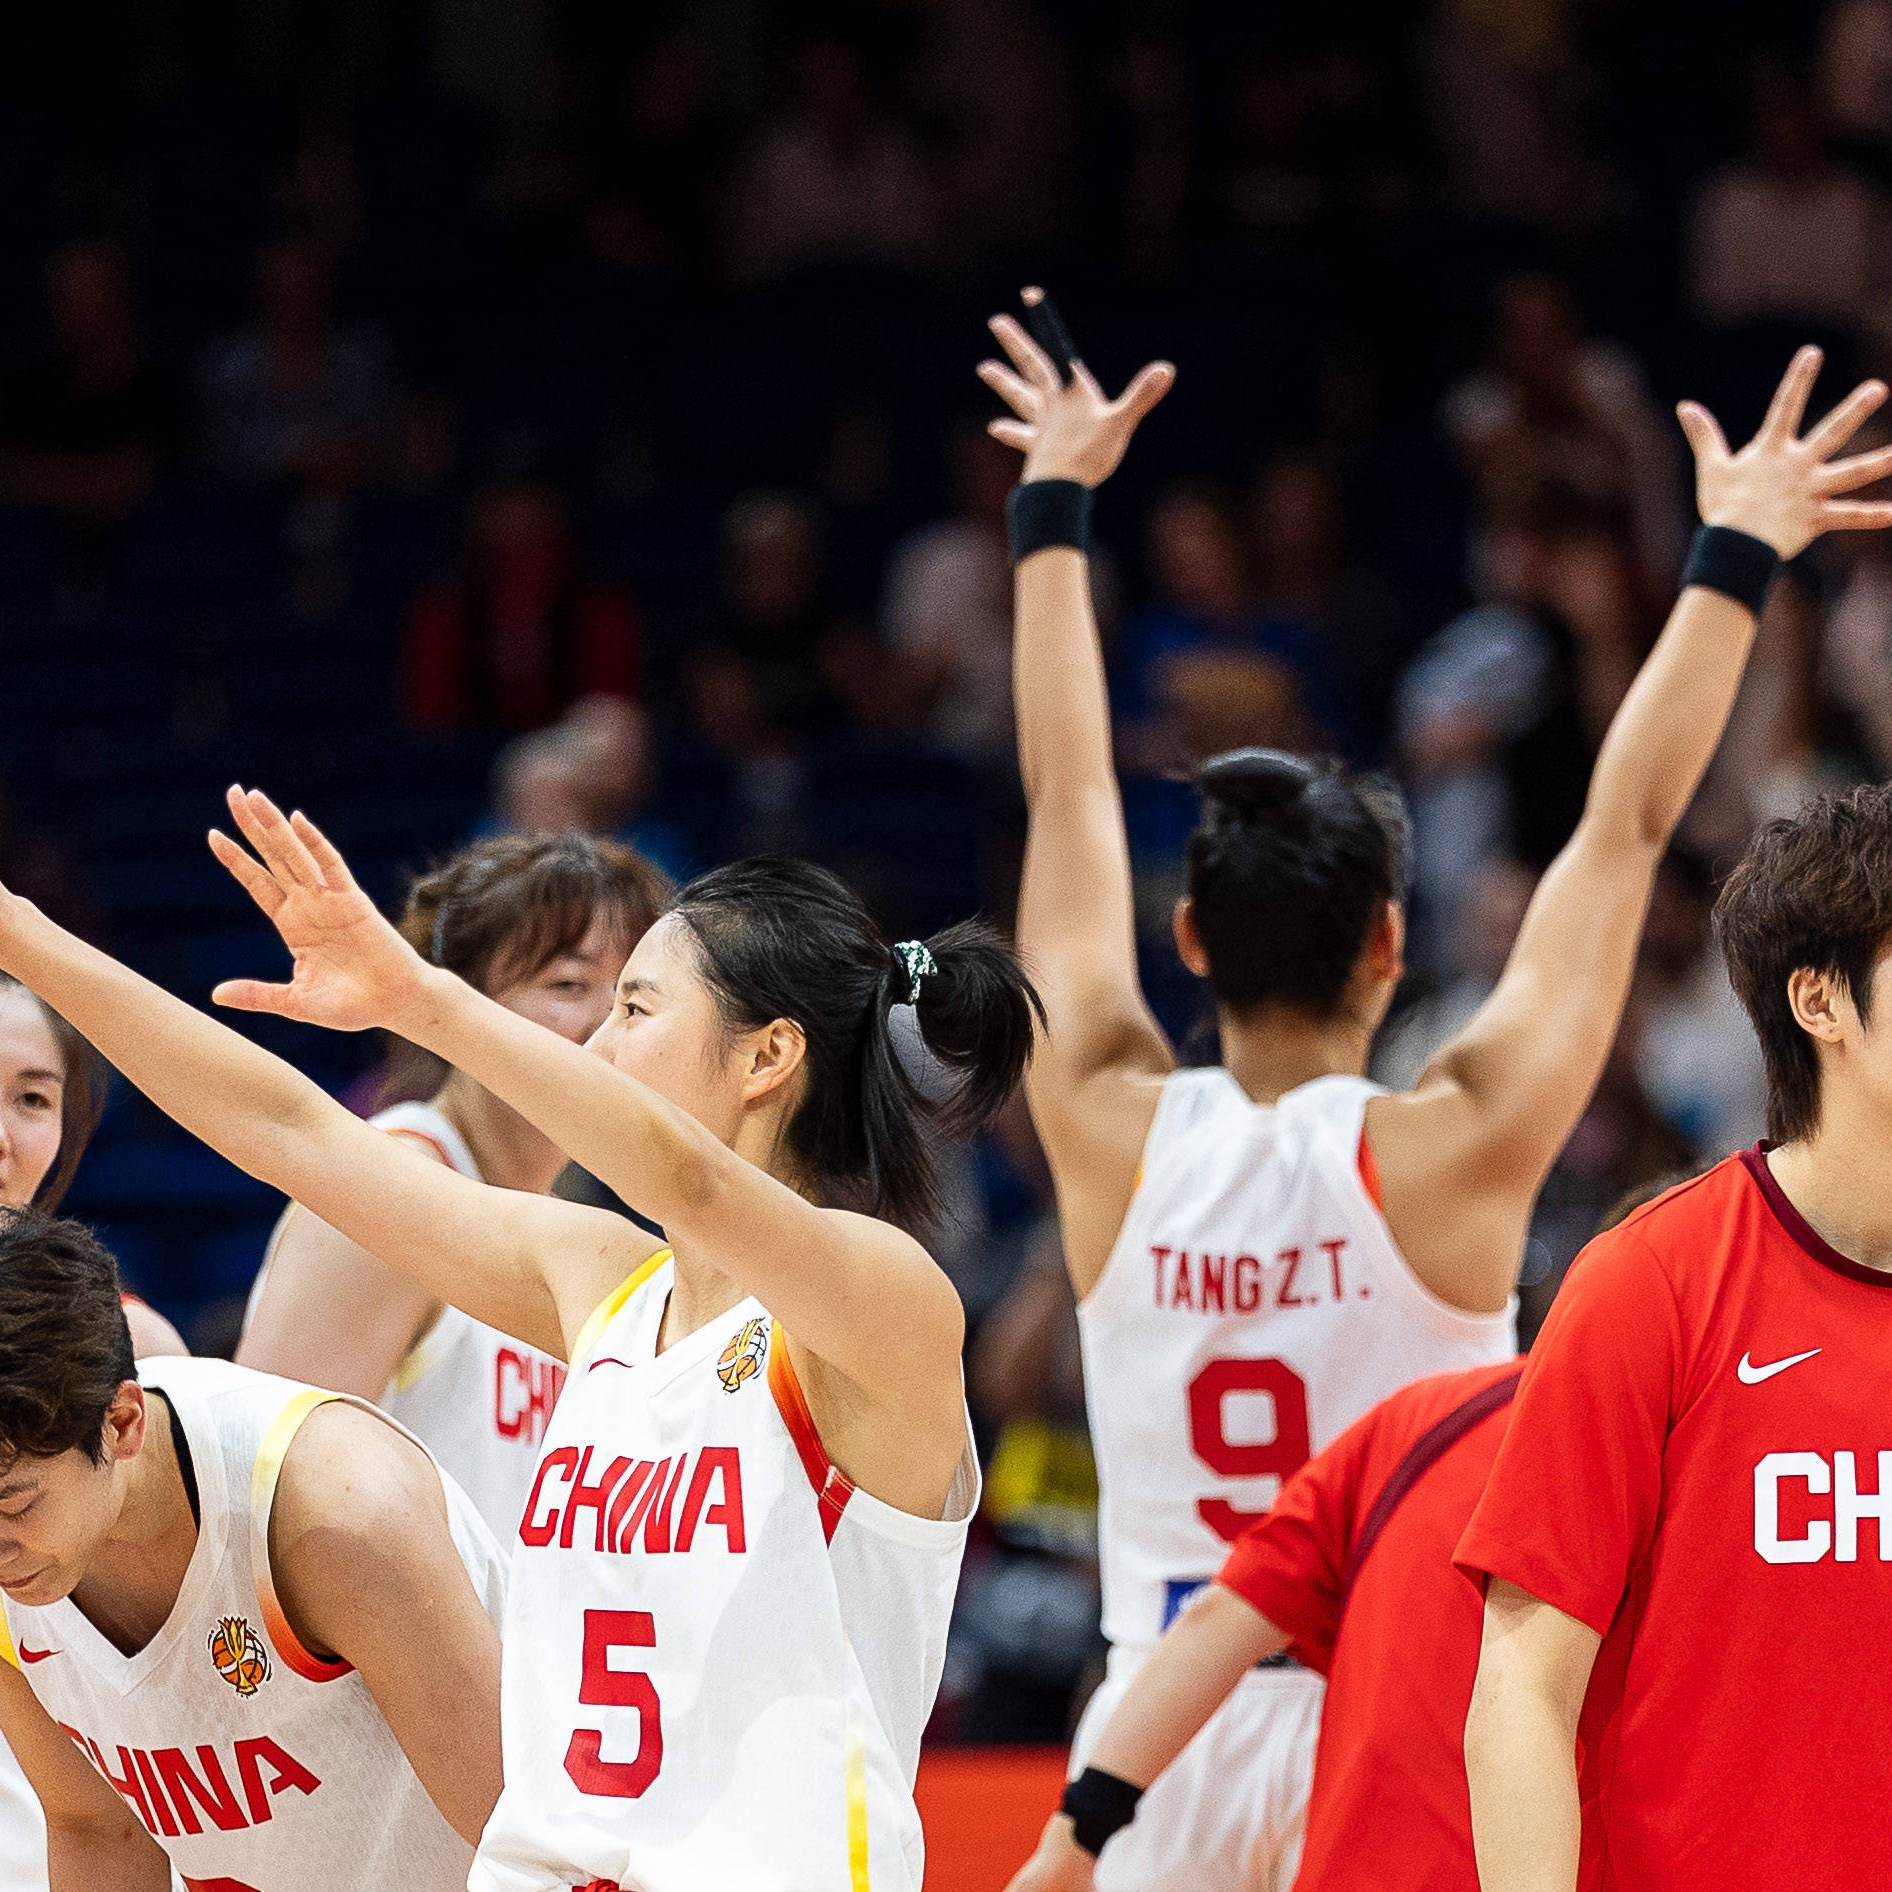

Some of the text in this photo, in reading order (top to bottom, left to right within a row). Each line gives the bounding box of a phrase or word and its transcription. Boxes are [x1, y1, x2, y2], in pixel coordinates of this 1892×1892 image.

[1150, 1240, 1371, 1314] TANG Z.T.
[519, 1446, 747, 1554] CHINA
[1189, 1359, 1311, 1543] 9
[564, 1609, 664, 1799] 5
